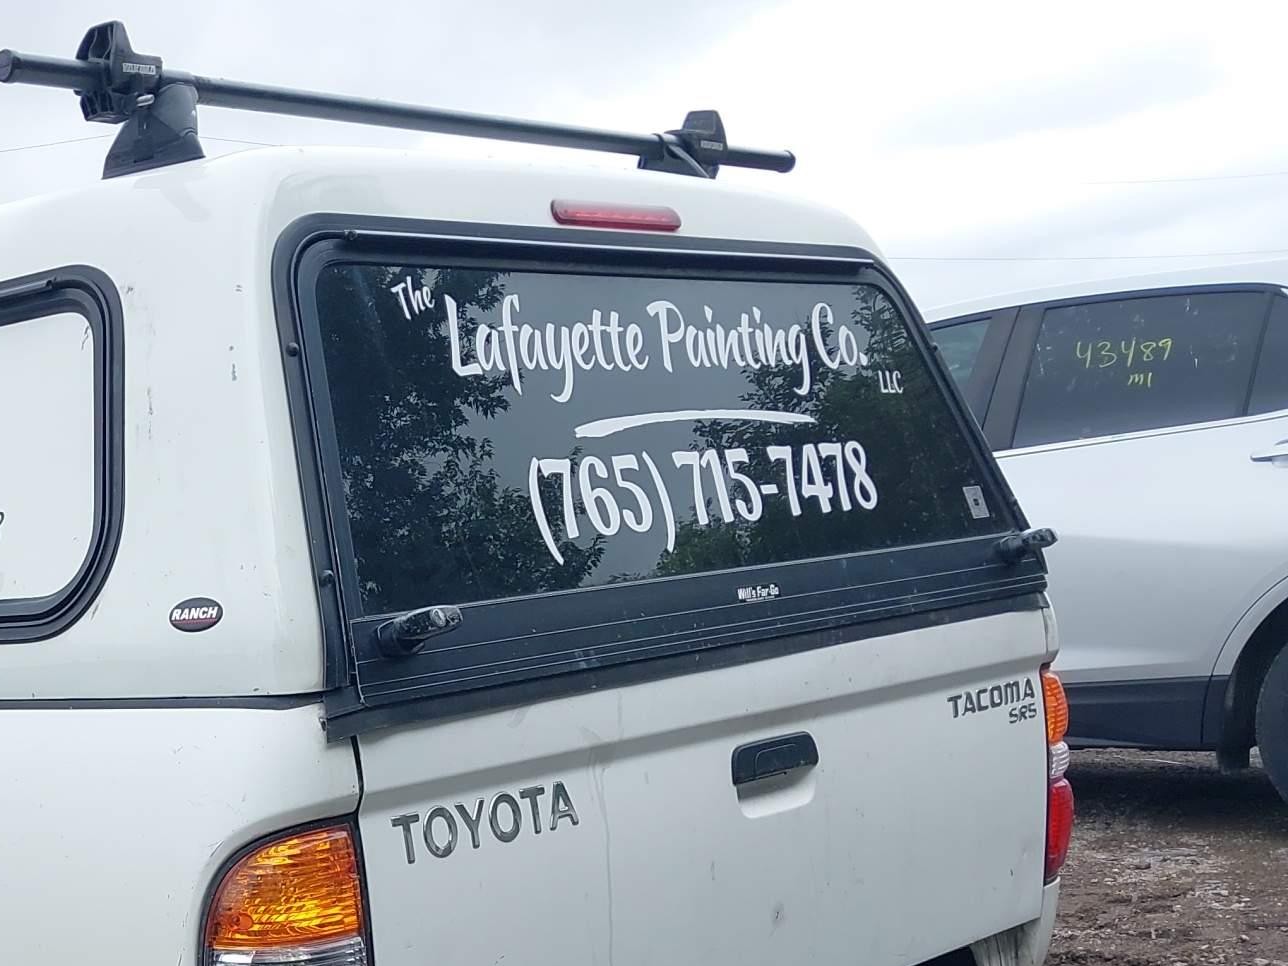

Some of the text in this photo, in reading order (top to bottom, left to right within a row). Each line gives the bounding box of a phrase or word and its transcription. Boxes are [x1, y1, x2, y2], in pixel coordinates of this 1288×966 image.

[391, 277, 868, 402] The Lafayette Painting Co.
[1076, 337, 1172, 369] 43489
[879, 371, 903, 393] LLC
[529, 441, 878, 564] (765) 715-7478
[171, 606, 219, 621] RANCH
[947, 678, 1035, 719] TACOMA
[1009, 702, 1037, 724] SR5
[391, 781, 580, 864] TOYOTA
